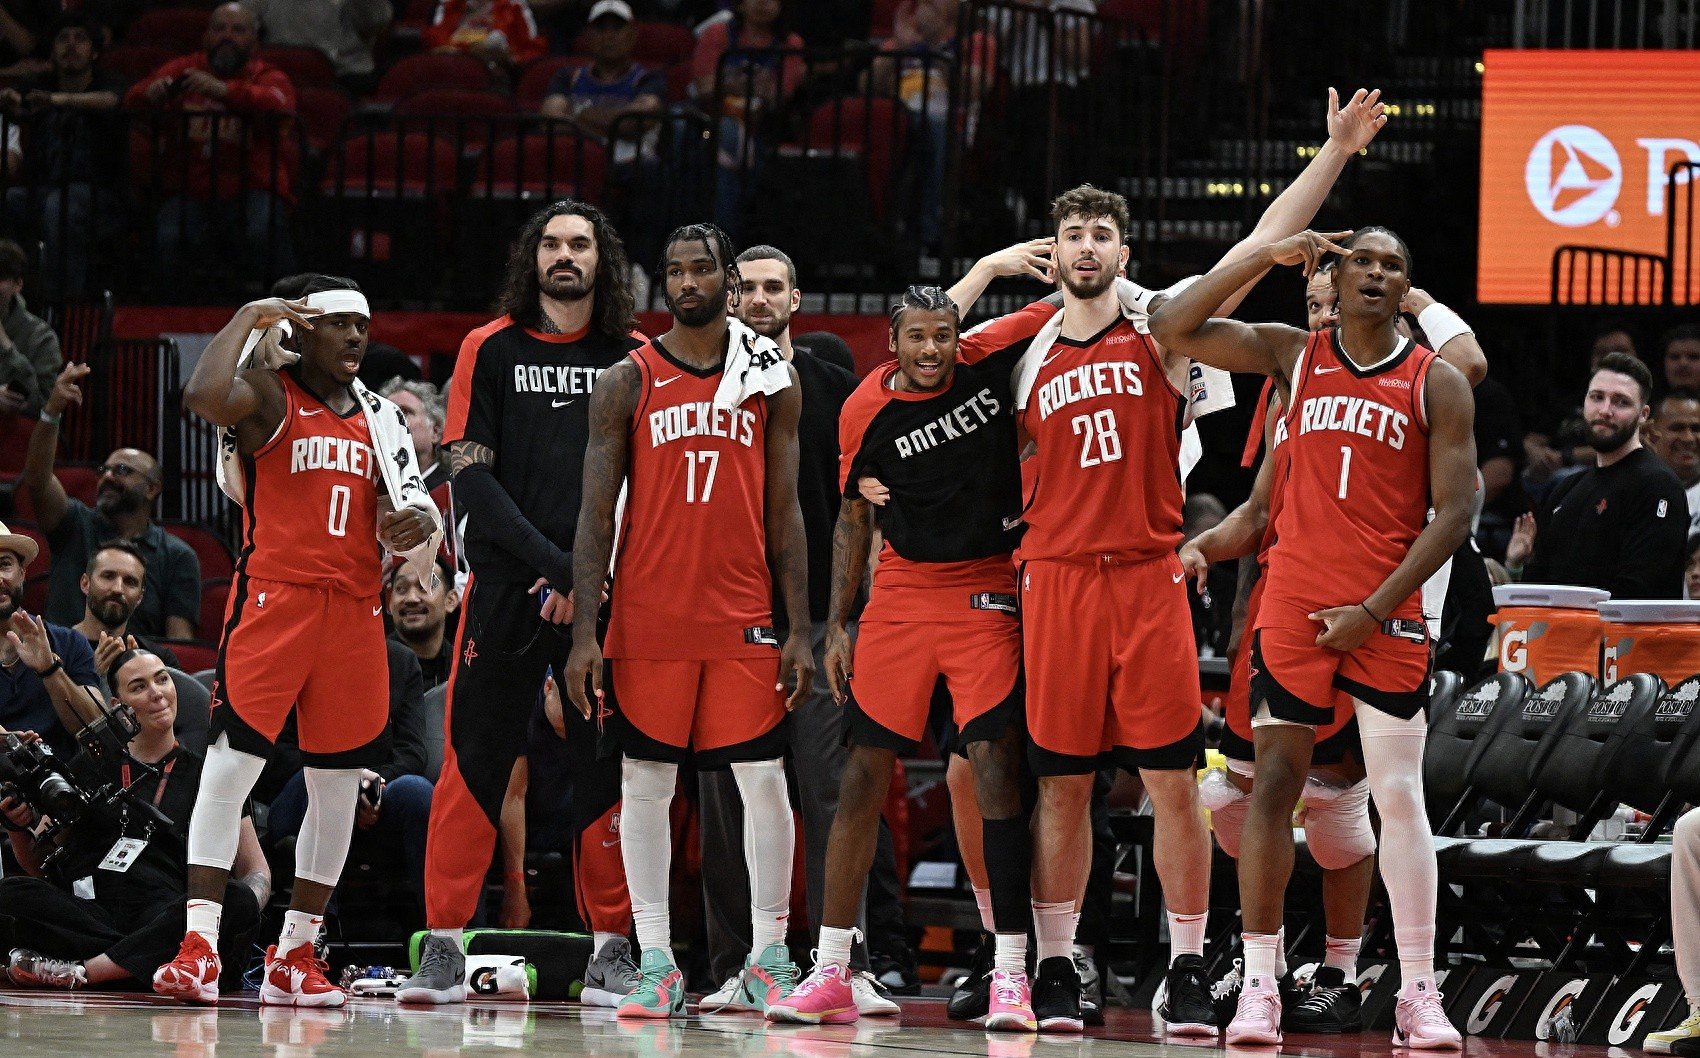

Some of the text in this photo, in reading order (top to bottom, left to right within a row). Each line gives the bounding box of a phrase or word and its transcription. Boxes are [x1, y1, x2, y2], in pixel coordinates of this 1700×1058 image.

[1038, 361, 1144, 421] ROCKETS
[649, 401, 756, 448] ROCKETS
[1071, 408, 1123, 469] 28
[1299, 396, 1409, 450] ROCKETS
[684, 450, 720, 504] 17
[1338, 445, 1352, 500] 1
[328, 484, 351, 537] 0
[1501, 630, 1528, 673] G
[470, 966, 498, 995] G
[1466, 974, 1519, 1035] G
[1608, 983, 1663, 1045] G
